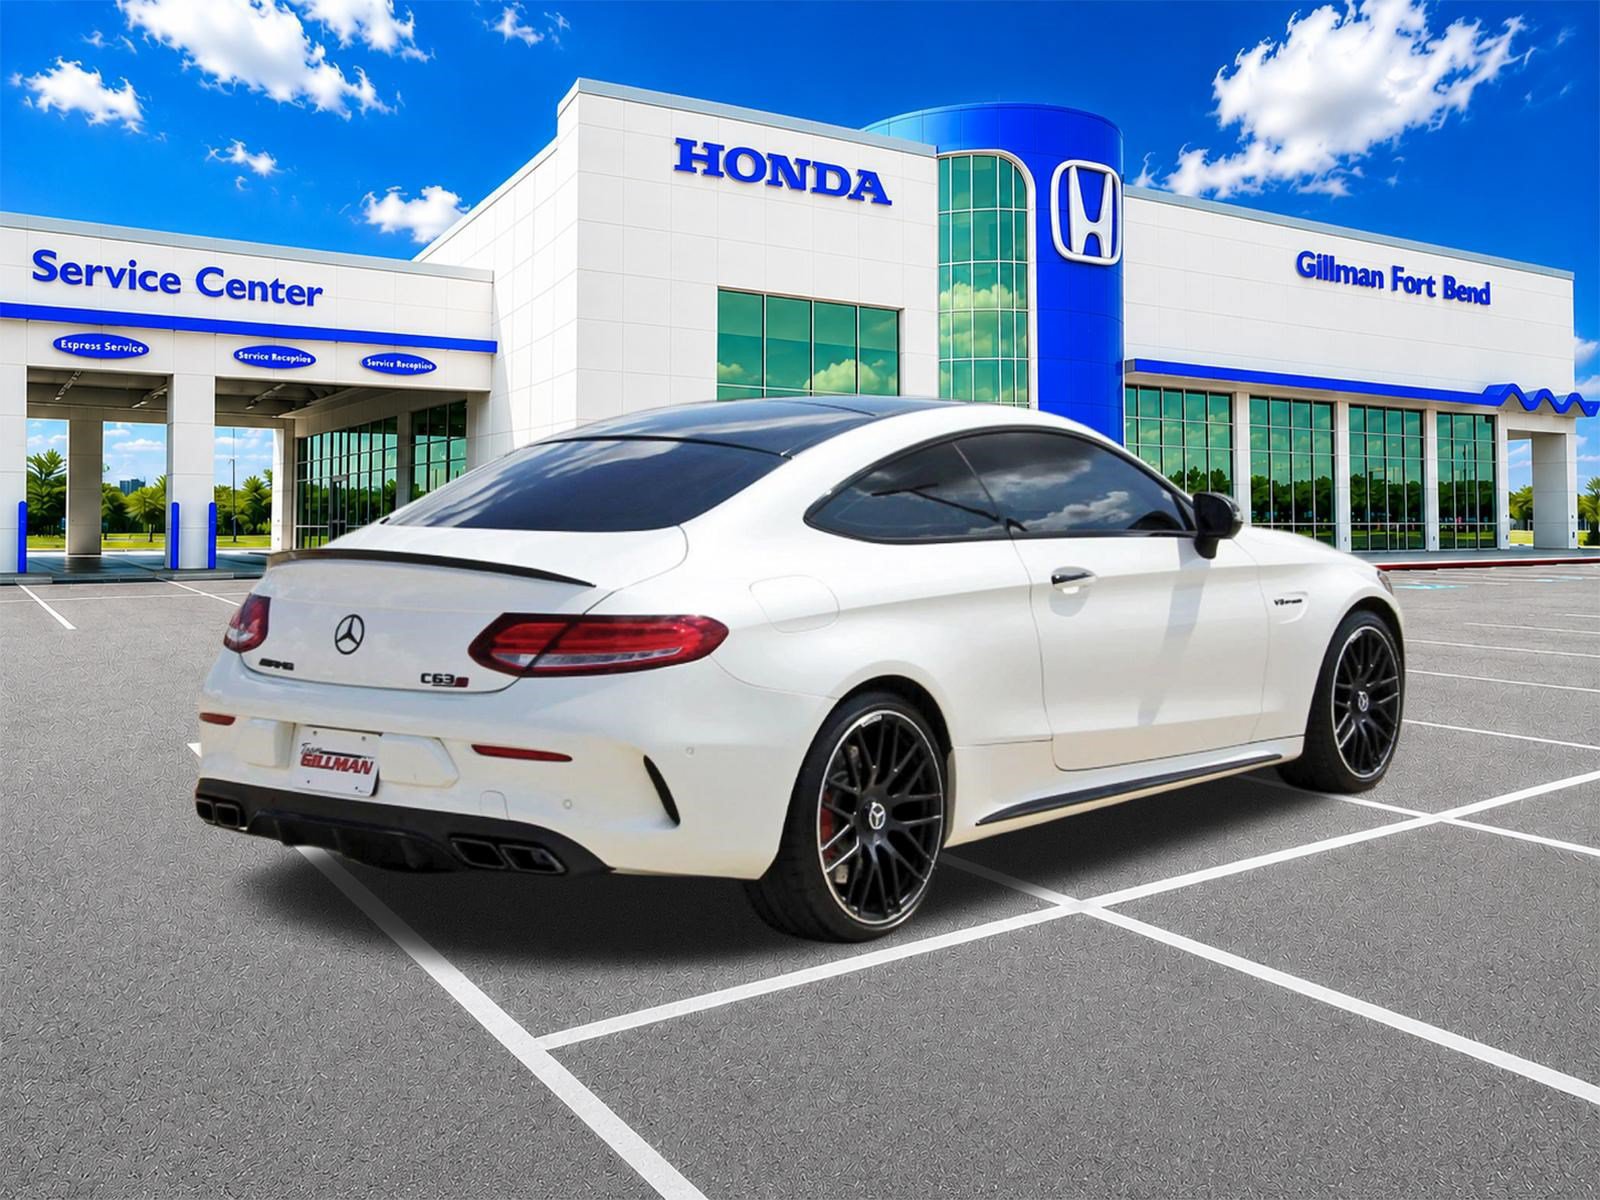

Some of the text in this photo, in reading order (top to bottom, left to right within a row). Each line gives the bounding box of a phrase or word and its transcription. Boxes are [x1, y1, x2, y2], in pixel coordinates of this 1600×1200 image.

[674, 137, 892, 206] HONDA
[32, 249, 324, 307] Service Center
[1296, 250, 1491, 305] Gillman Fort Bend
[104, 342, 144, 353] Service
[238, 351, 269, 361] Service
[366, 358, 394, 367] Service
[301, 753, 374, 775] GILLMAN
